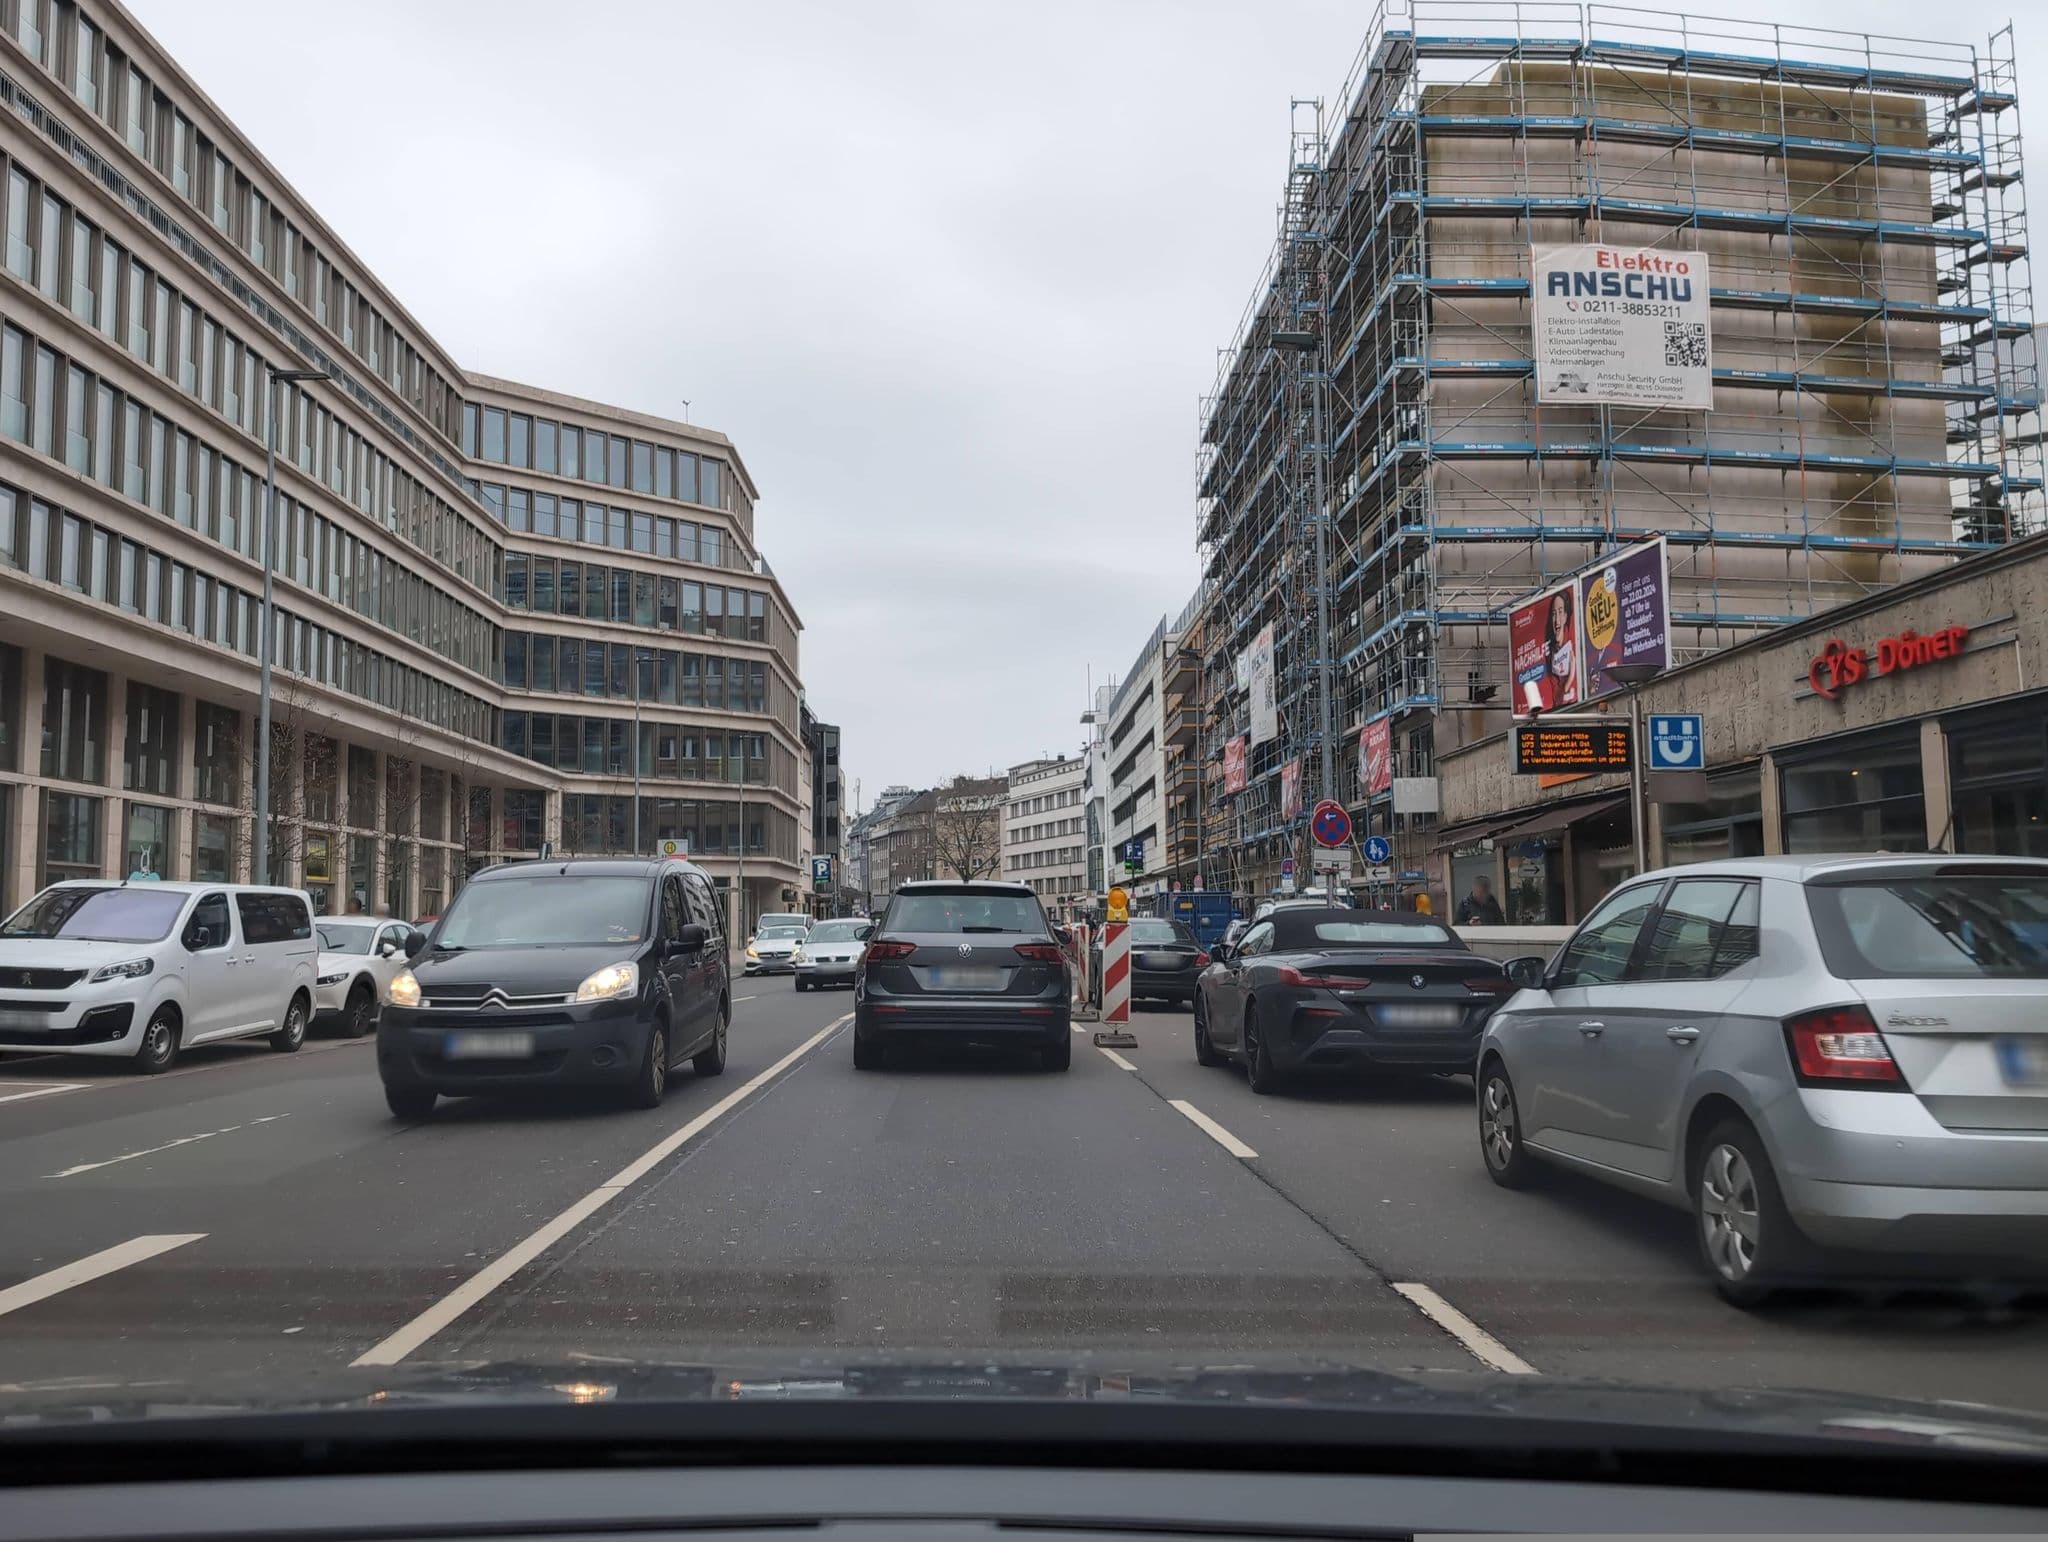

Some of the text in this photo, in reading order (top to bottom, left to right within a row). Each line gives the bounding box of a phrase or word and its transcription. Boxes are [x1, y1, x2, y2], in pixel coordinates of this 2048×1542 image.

[1596, 250, 1689, 275] Elektro
[1547, 271, 1692, 302] ANSCHU
[1582, 301, 1682, 318] 0211-38853211
[1579, 327, 1624, 336] Ladestation
[1548, 337, 1617, 347] Klimaanlagenbau
[1548, 348, 1625, 359] Videoüberwachung
[1549, 358, 1606, 367] Alarmanlagen
[1597, 372, 1682, 385] Anschu Security GmbH
[1590, 596, 1616, 628] NEU-
[1635, 601, 1644, 614] Uhr
[1514, 639, 1551, 672] NACHHILFE
[1876, 625, 1969, 675] Döner
[1540, 733, 1570, 741] Ratingen
[1657, 720, 1693, 764] U
